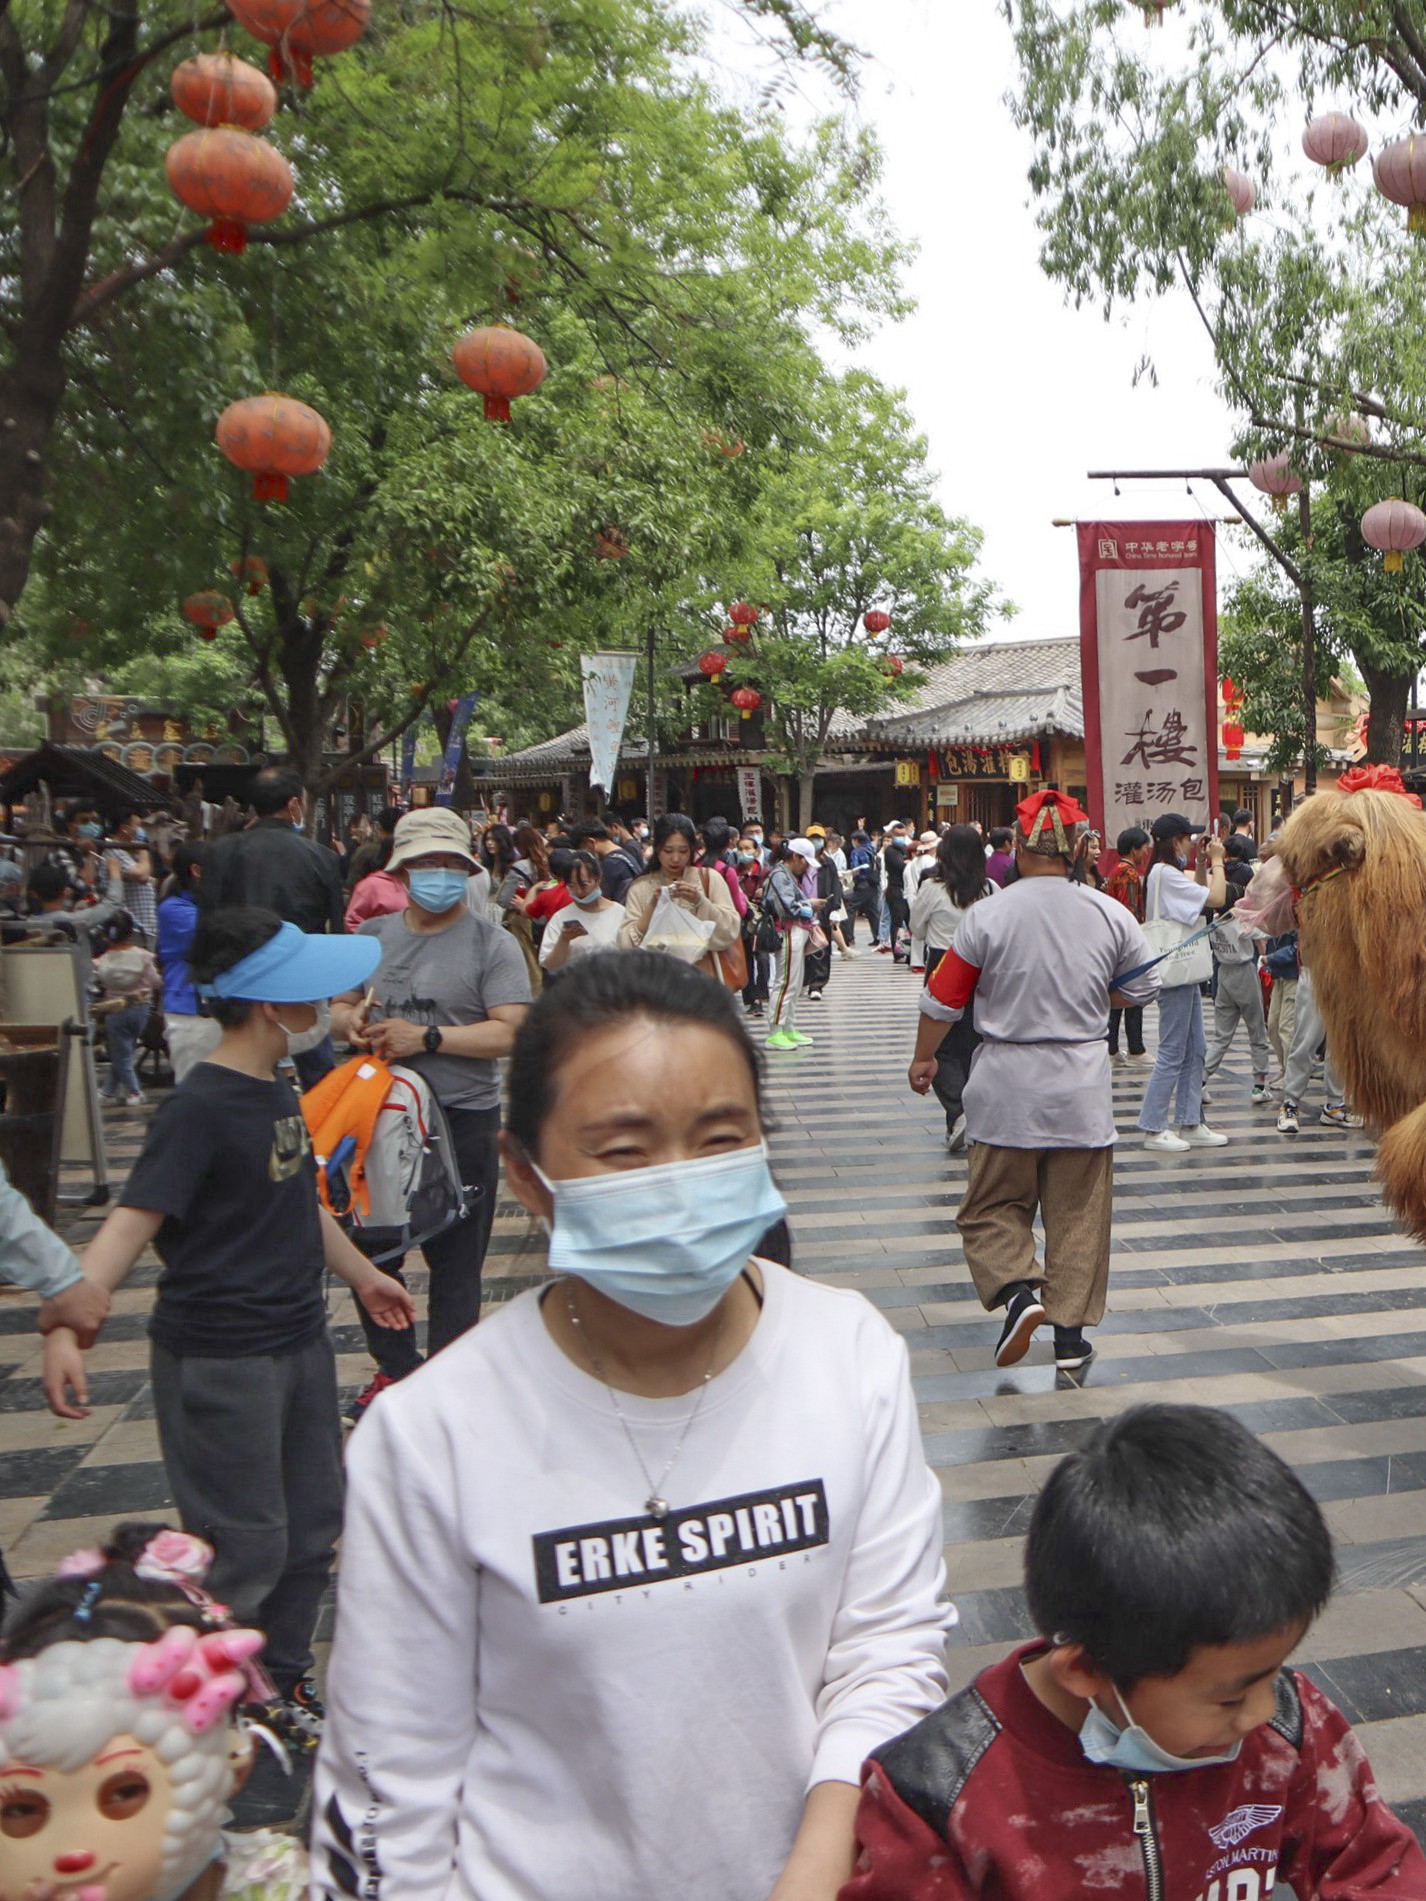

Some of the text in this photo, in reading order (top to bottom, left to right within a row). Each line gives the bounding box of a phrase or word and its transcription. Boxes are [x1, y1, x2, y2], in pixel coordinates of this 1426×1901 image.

[1124, 540, 1198, 553] 中华老字号
[1114, 777, 1206, 806] 灌汤包
[554, 1493, 818, 1588] ERKE SPIRIT
[557, 1553, 812, 1617] CITY RIDER
